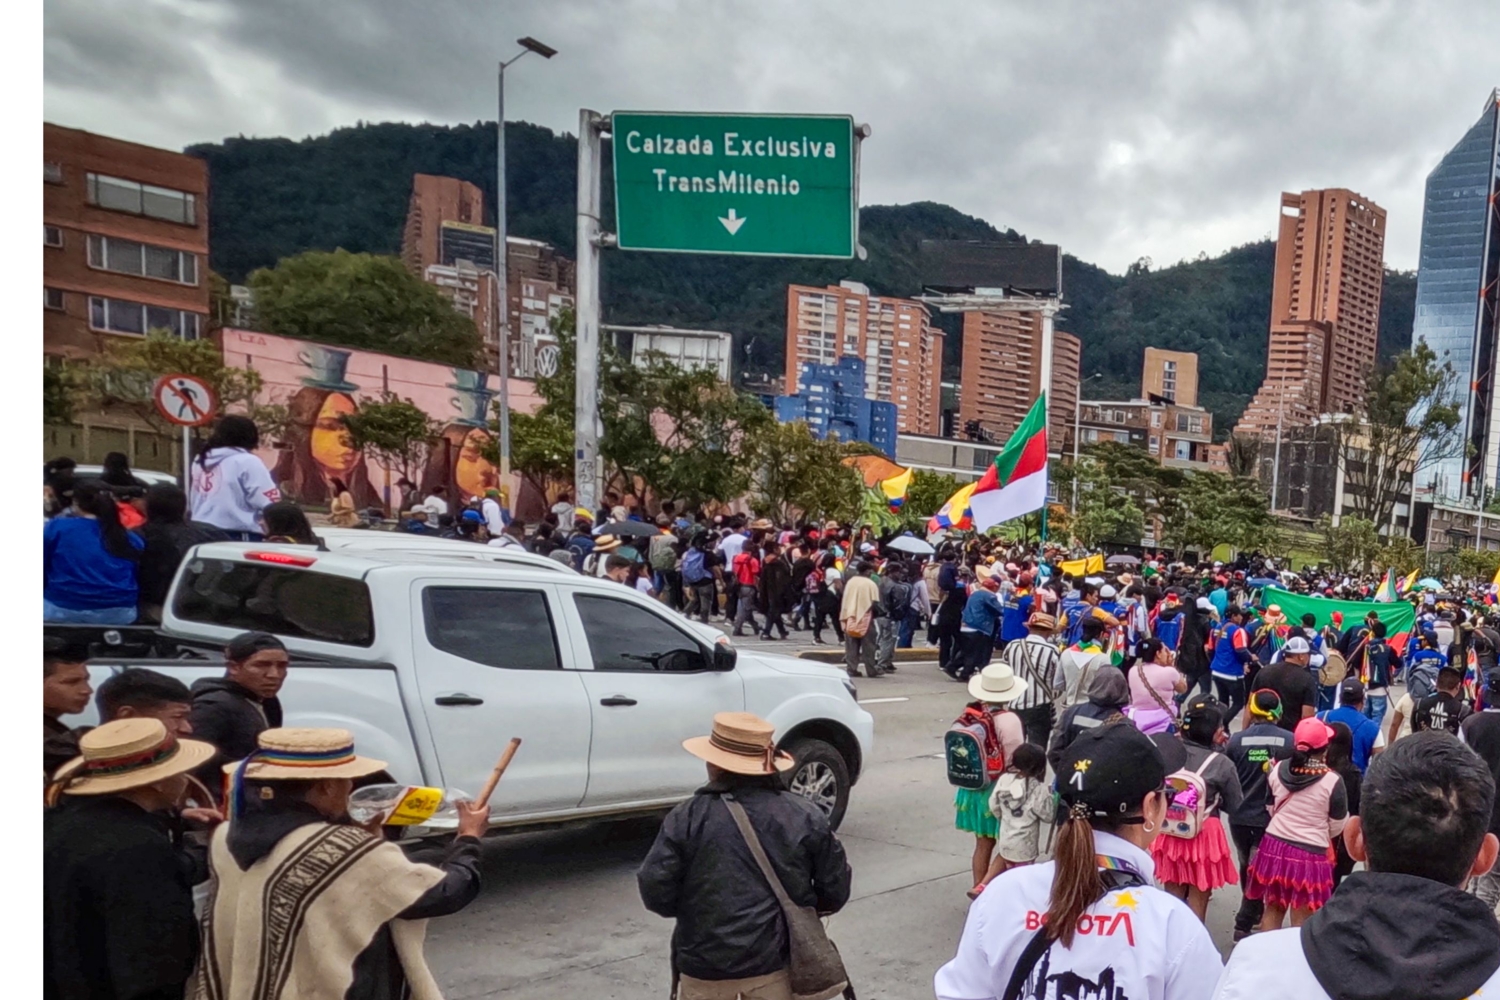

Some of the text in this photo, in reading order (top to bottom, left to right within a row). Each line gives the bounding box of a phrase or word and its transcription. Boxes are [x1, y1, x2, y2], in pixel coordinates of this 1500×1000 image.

[626, 130, 836, 158] Calzada Exclusiva
[652, 168, 800, 195] TransMilenio
